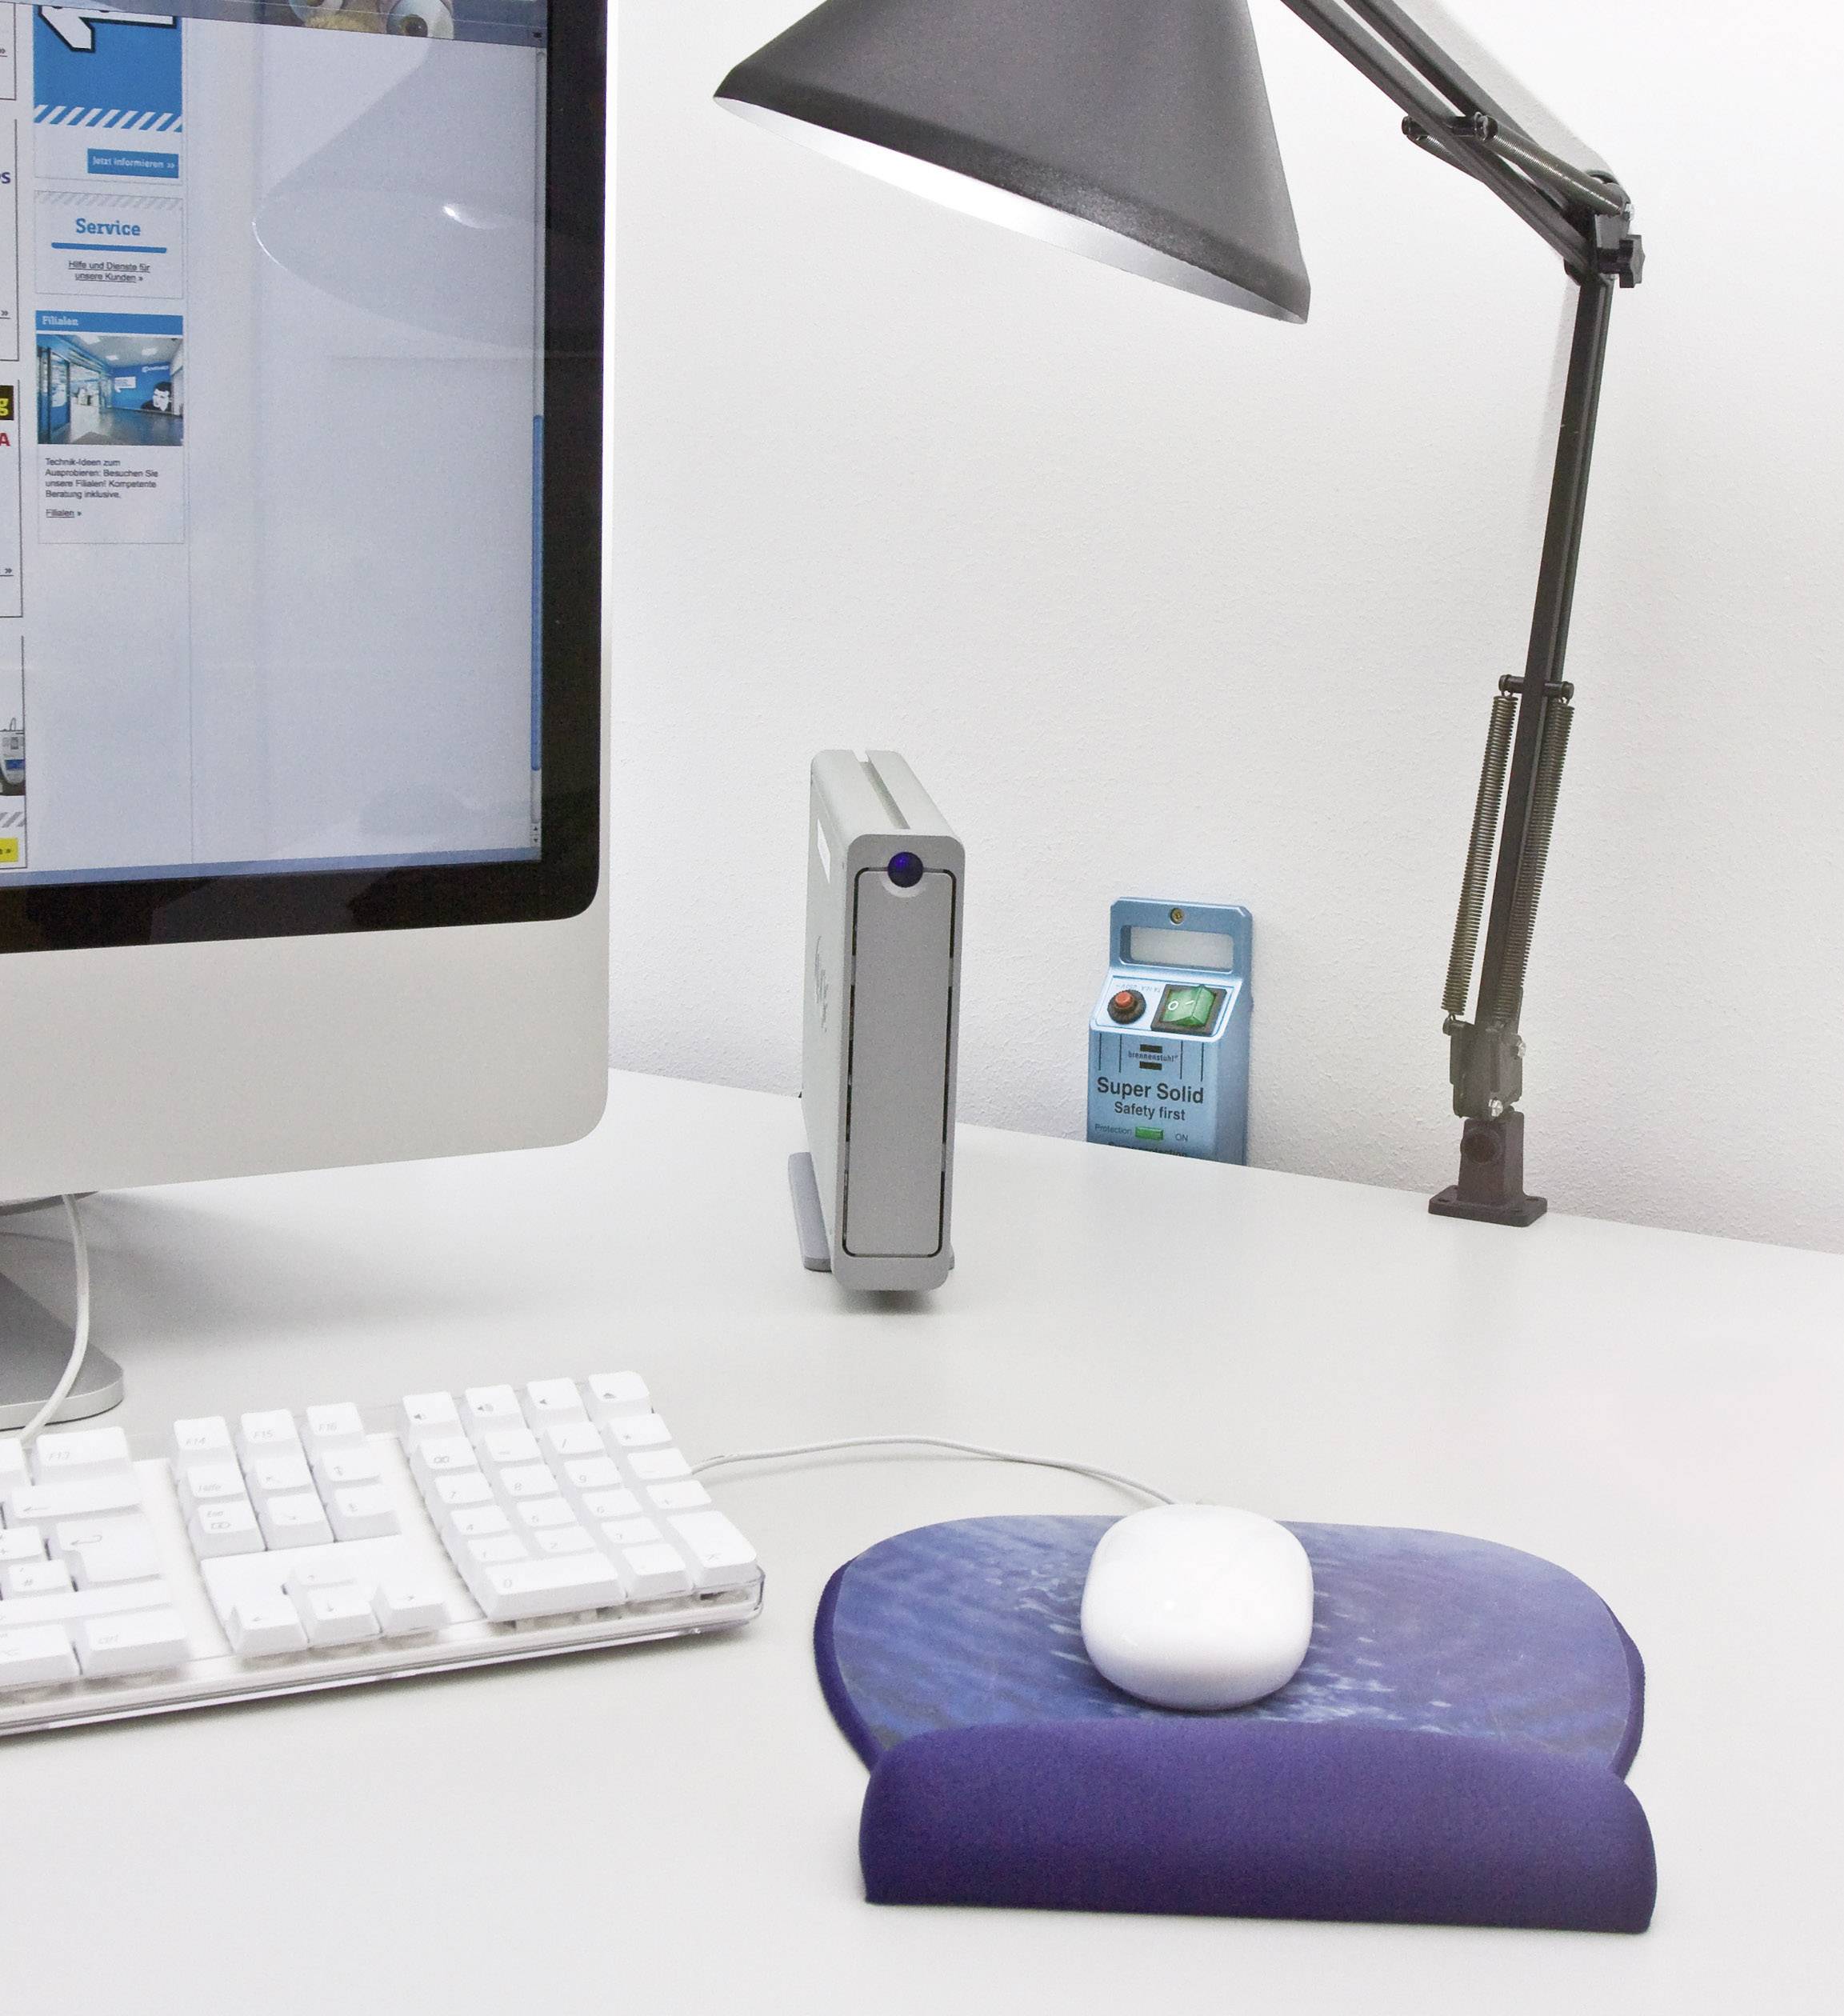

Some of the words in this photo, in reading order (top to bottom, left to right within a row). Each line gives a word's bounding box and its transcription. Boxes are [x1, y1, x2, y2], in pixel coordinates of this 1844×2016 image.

[114, 158, 164, 168] informieren
[75, 218, 141, 236] Service
[68, 260, 86, 268] Hilfe
[89, 262, 104, 270] und
[106, 262, 137, 270] Dienste
[139, 263, 150, 271] für
[105, 274, 136, 282] Kunden
[42, 315, 78, 326] Filialen
[103, 469, 143, 477] Besuchen
[145, 470, 158, 478] Sie
[109, 480, 157, 489] Kompetente
[46, 490, 82, 499] Beratung
[46, 509, 74, 517] Filialen
[1097, 1076, 1152, 1099] Super
[1157, 1082, 1204, 1104] Solid
[1114, 1101, 1155, 1120] Safety
[1159, 1106, 1186, 1121] first
[1094, 1123, 1132, 1134] Protection
[1174, 1133, 1189, 1142] ON
